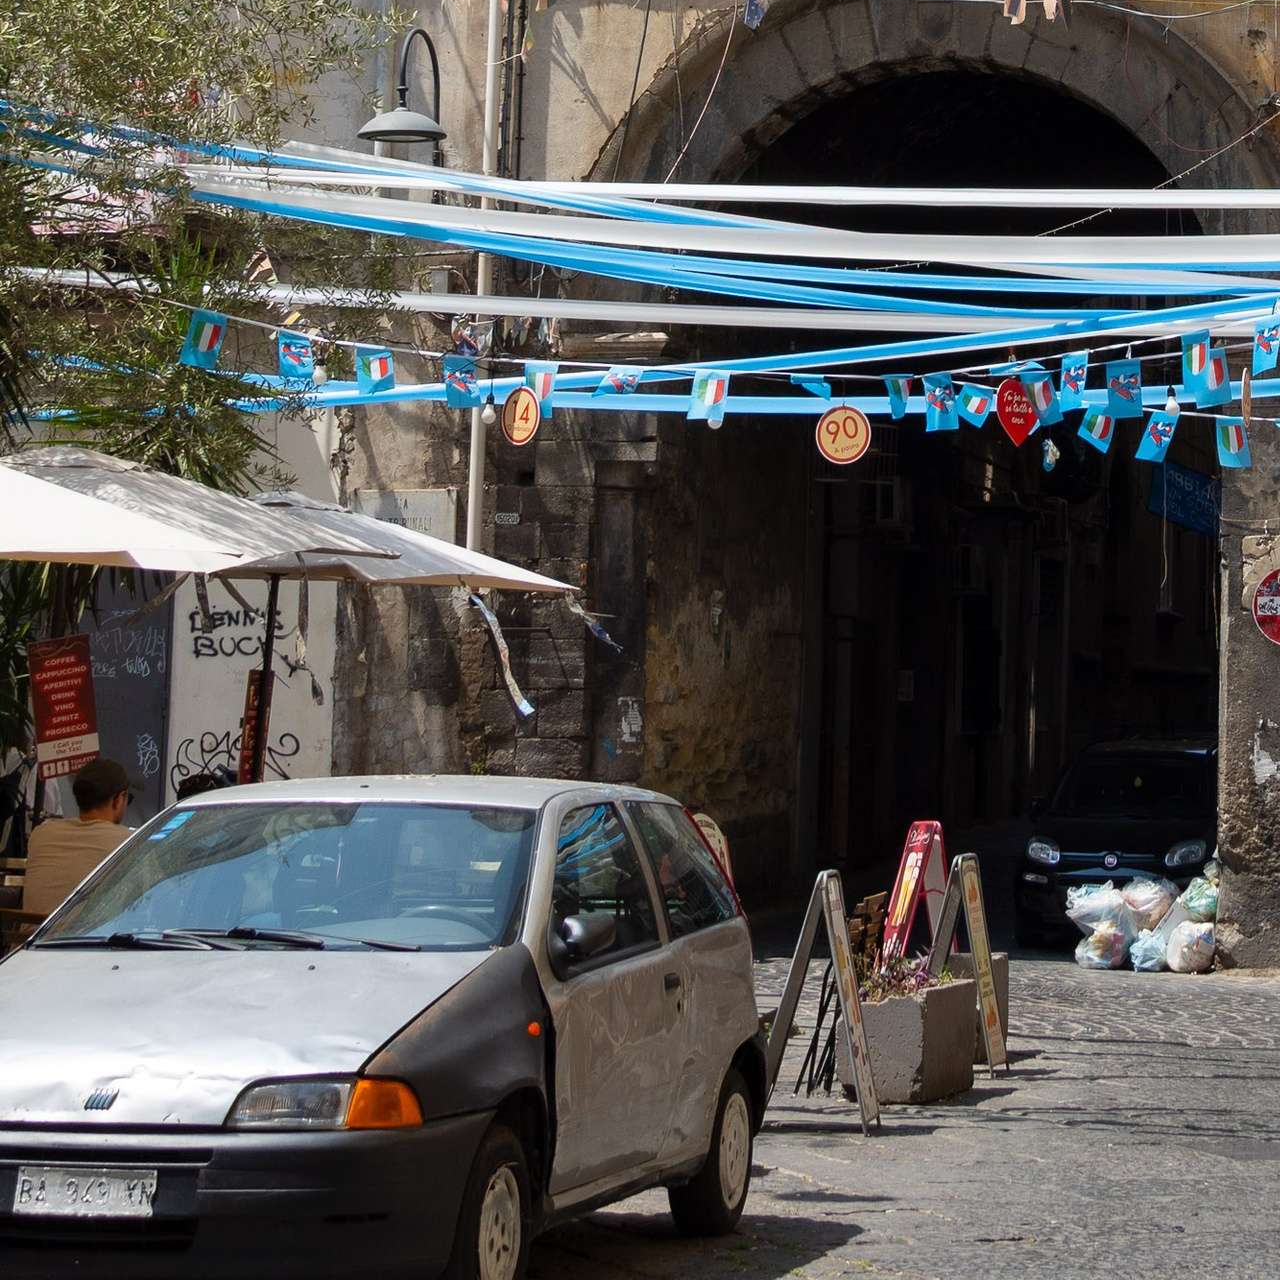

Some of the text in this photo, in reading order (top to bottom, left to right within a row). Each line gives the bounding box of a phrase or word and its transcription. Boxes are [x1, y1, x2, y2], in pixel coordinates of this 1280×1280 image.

[512, 400, 530, 424] 14
[826, 415, 858, 444] 90
[45, 655, 76, 667] COFFEE
[36, 665, 87, 680] CAPPUCCINO
[44, 678, 82, 690] APERITIVI
[51, 690, 76, 701] DRINK
[55, 702, 75, 711] VINO
[52, 713, 80, 724] SPRITZ
[46, 723, 88, 737] PROSECCO
